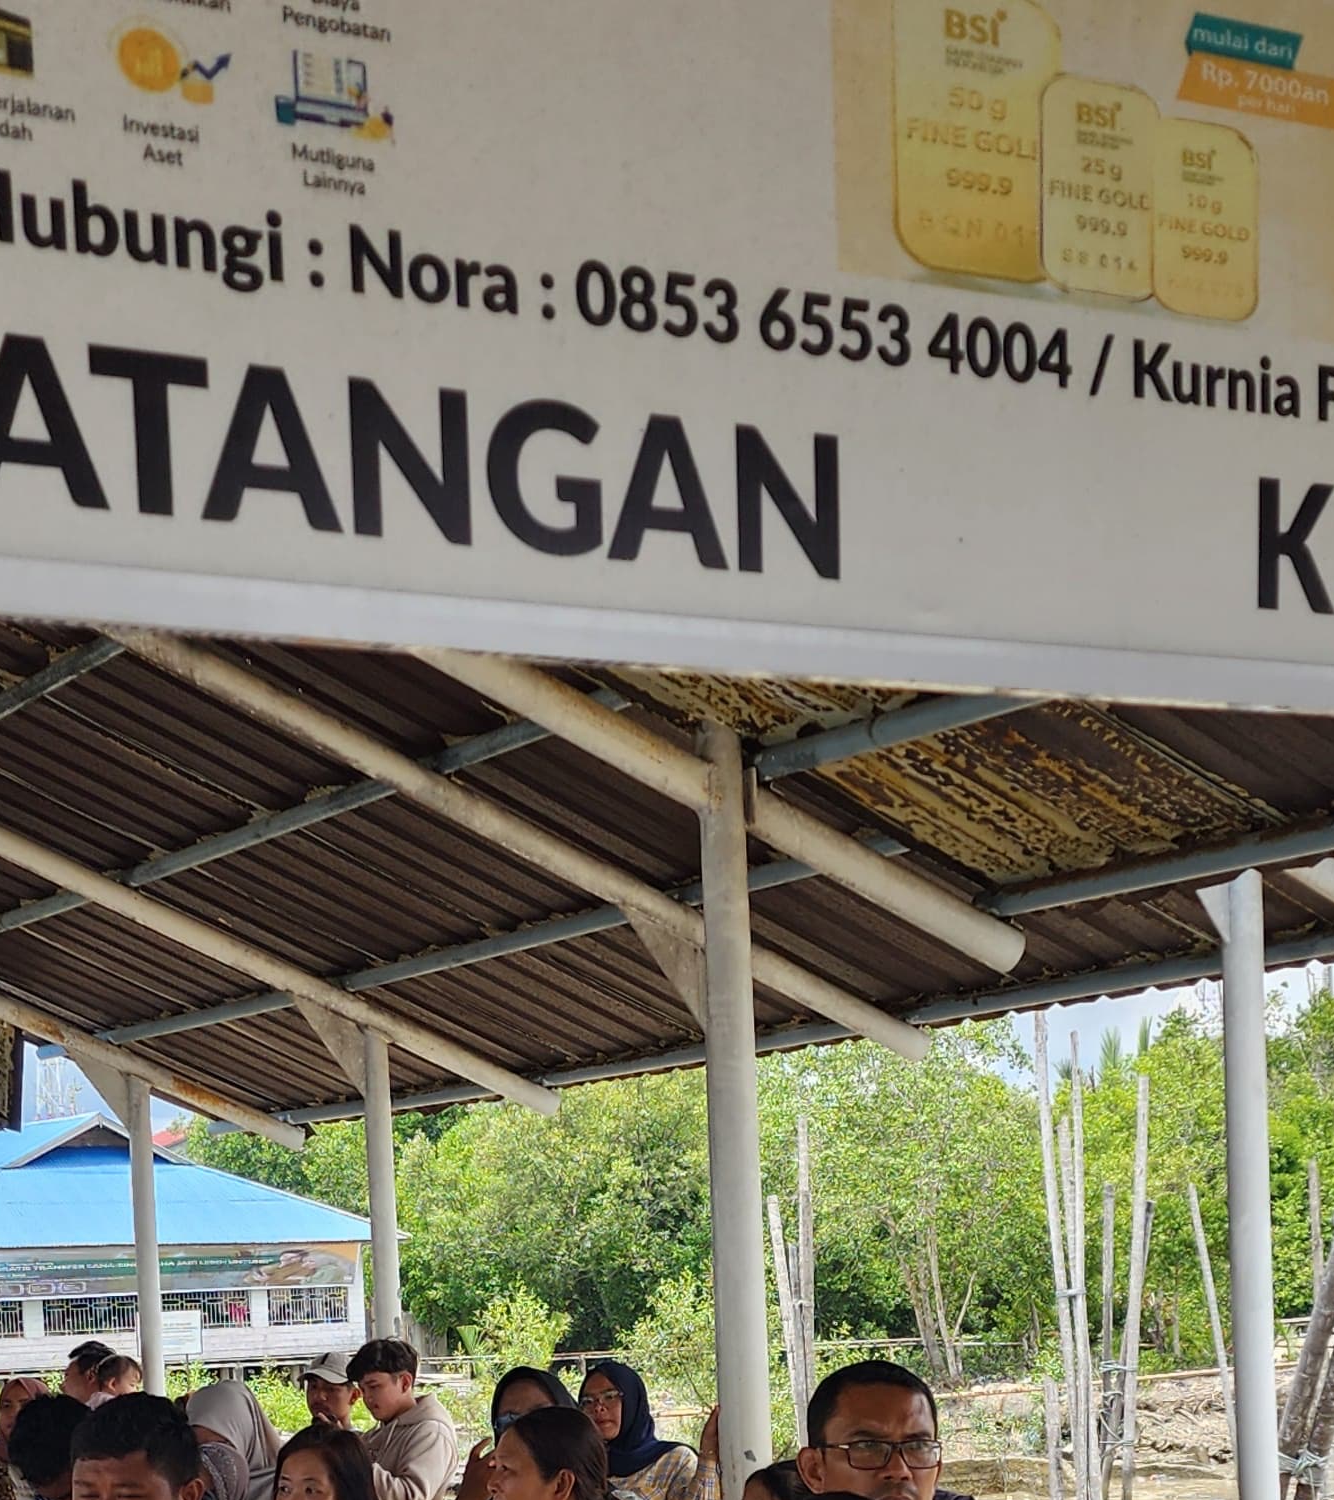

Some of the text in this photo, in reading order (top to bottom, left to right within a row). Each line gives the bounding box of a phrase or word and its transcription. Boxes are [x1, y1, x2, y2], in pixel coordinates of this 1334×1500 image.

[282, 5, 391, 42] Pengobatan
[944, 8, 1005, 47] BSI
[1193, 27, 1293, 59] mulai dari
[1201, 60, 1329, 105] Rp. 7000an
[123, 113, 199, 143] Investasi
[1076, 101, 1122, 129] BSI
[906, 117, 967, 148] FINE
[143, 142, 184, 166] Aset
[1182, 148, 1217, 171] BSI
[303, 169, 367, 197] Lainnya
[946, 167, 1014, 197] 999.9
[1081, 156, 1123, 182] 25 g
[1049, 180, 1094, 202] FINE
[1075, 214, 1129, 238] 999.9
[1158, 215, 1251, 242] FINE GOLD
[1181, 245, 1229, 265] 999.9
[308, 237, 324, 288] :
[348, 223, 519, 315] Nora
[540, 272, 556, 320] :
[576, 259, 740, 343] 0853
[760, 287, 911, 367] 6553
[927, 312, 1072, 389] 4004
[1089, 334, 1114, 397] /
[1133, 338, 1301, 419] Kurnia
